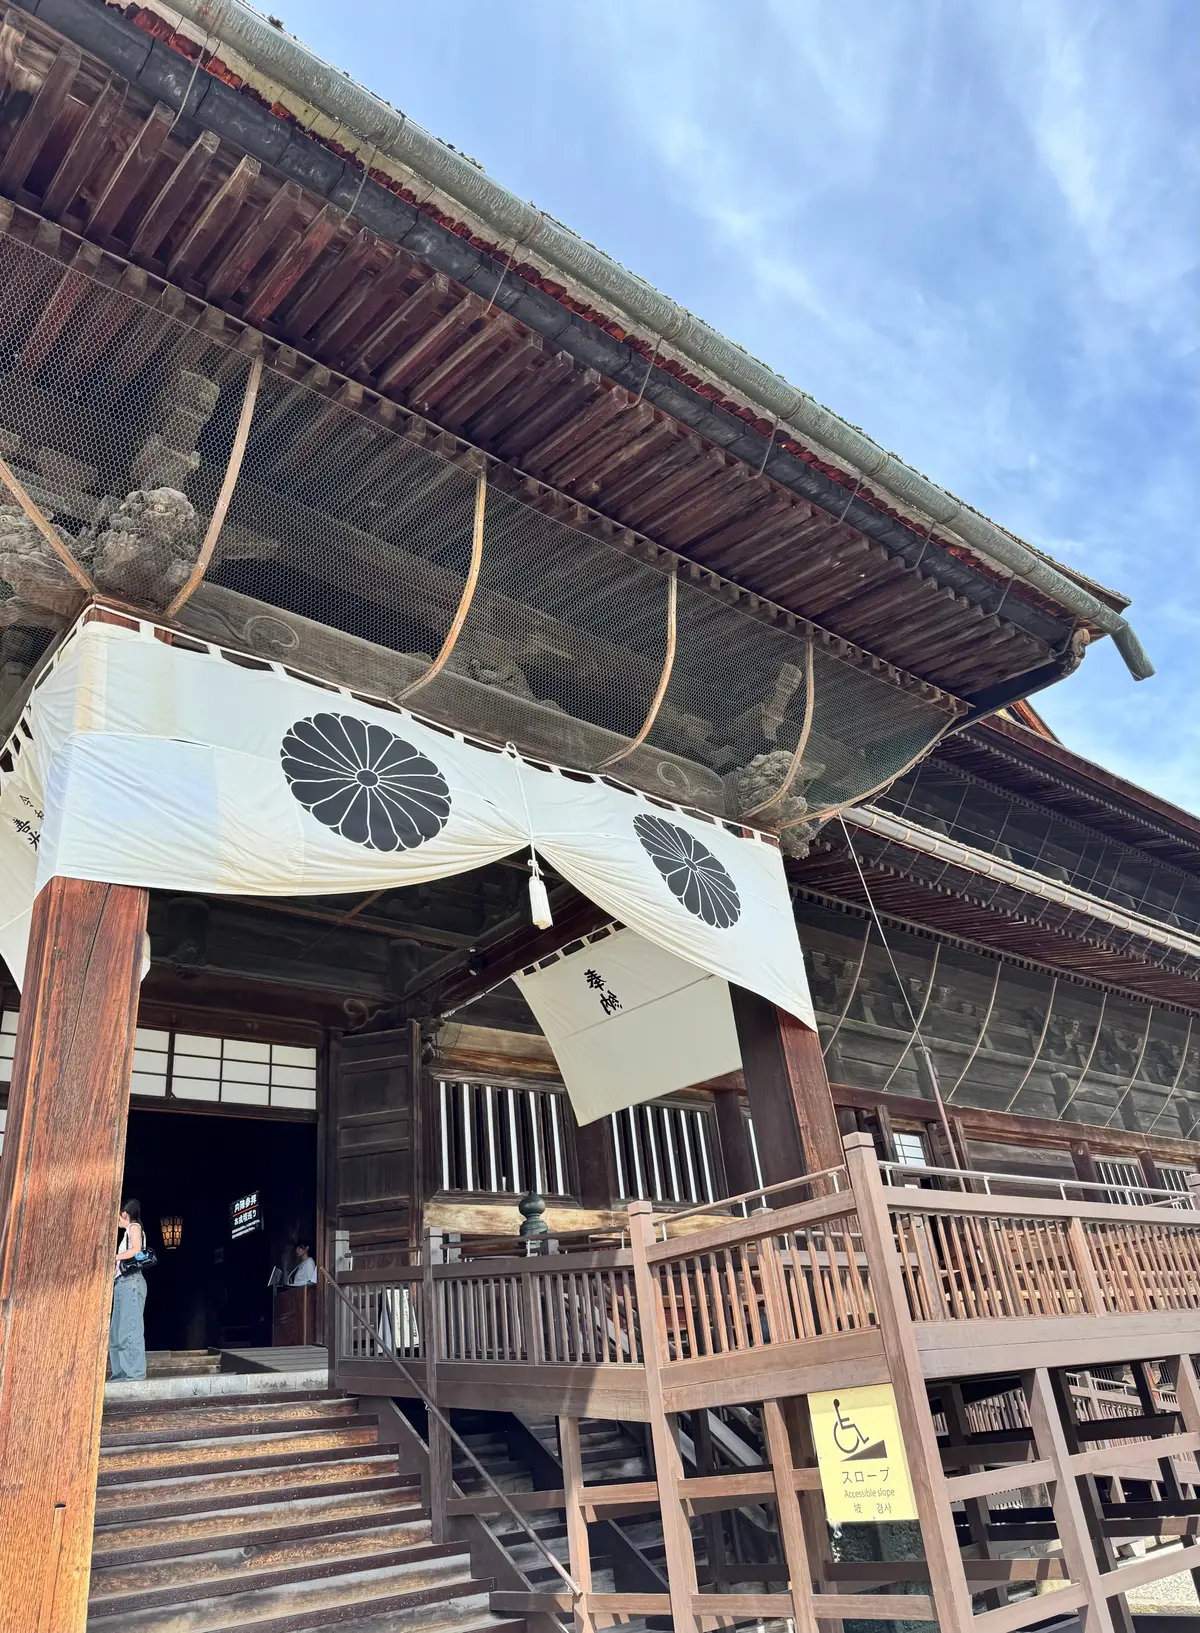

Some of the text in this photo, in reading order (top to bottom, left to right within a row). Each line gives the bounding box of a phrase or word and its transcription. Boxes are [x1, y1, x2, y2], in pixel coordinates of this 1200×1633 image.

[842, 1466, 889, 1484] スロープ
[844, 1487, 895, 1499] Accessible slope
